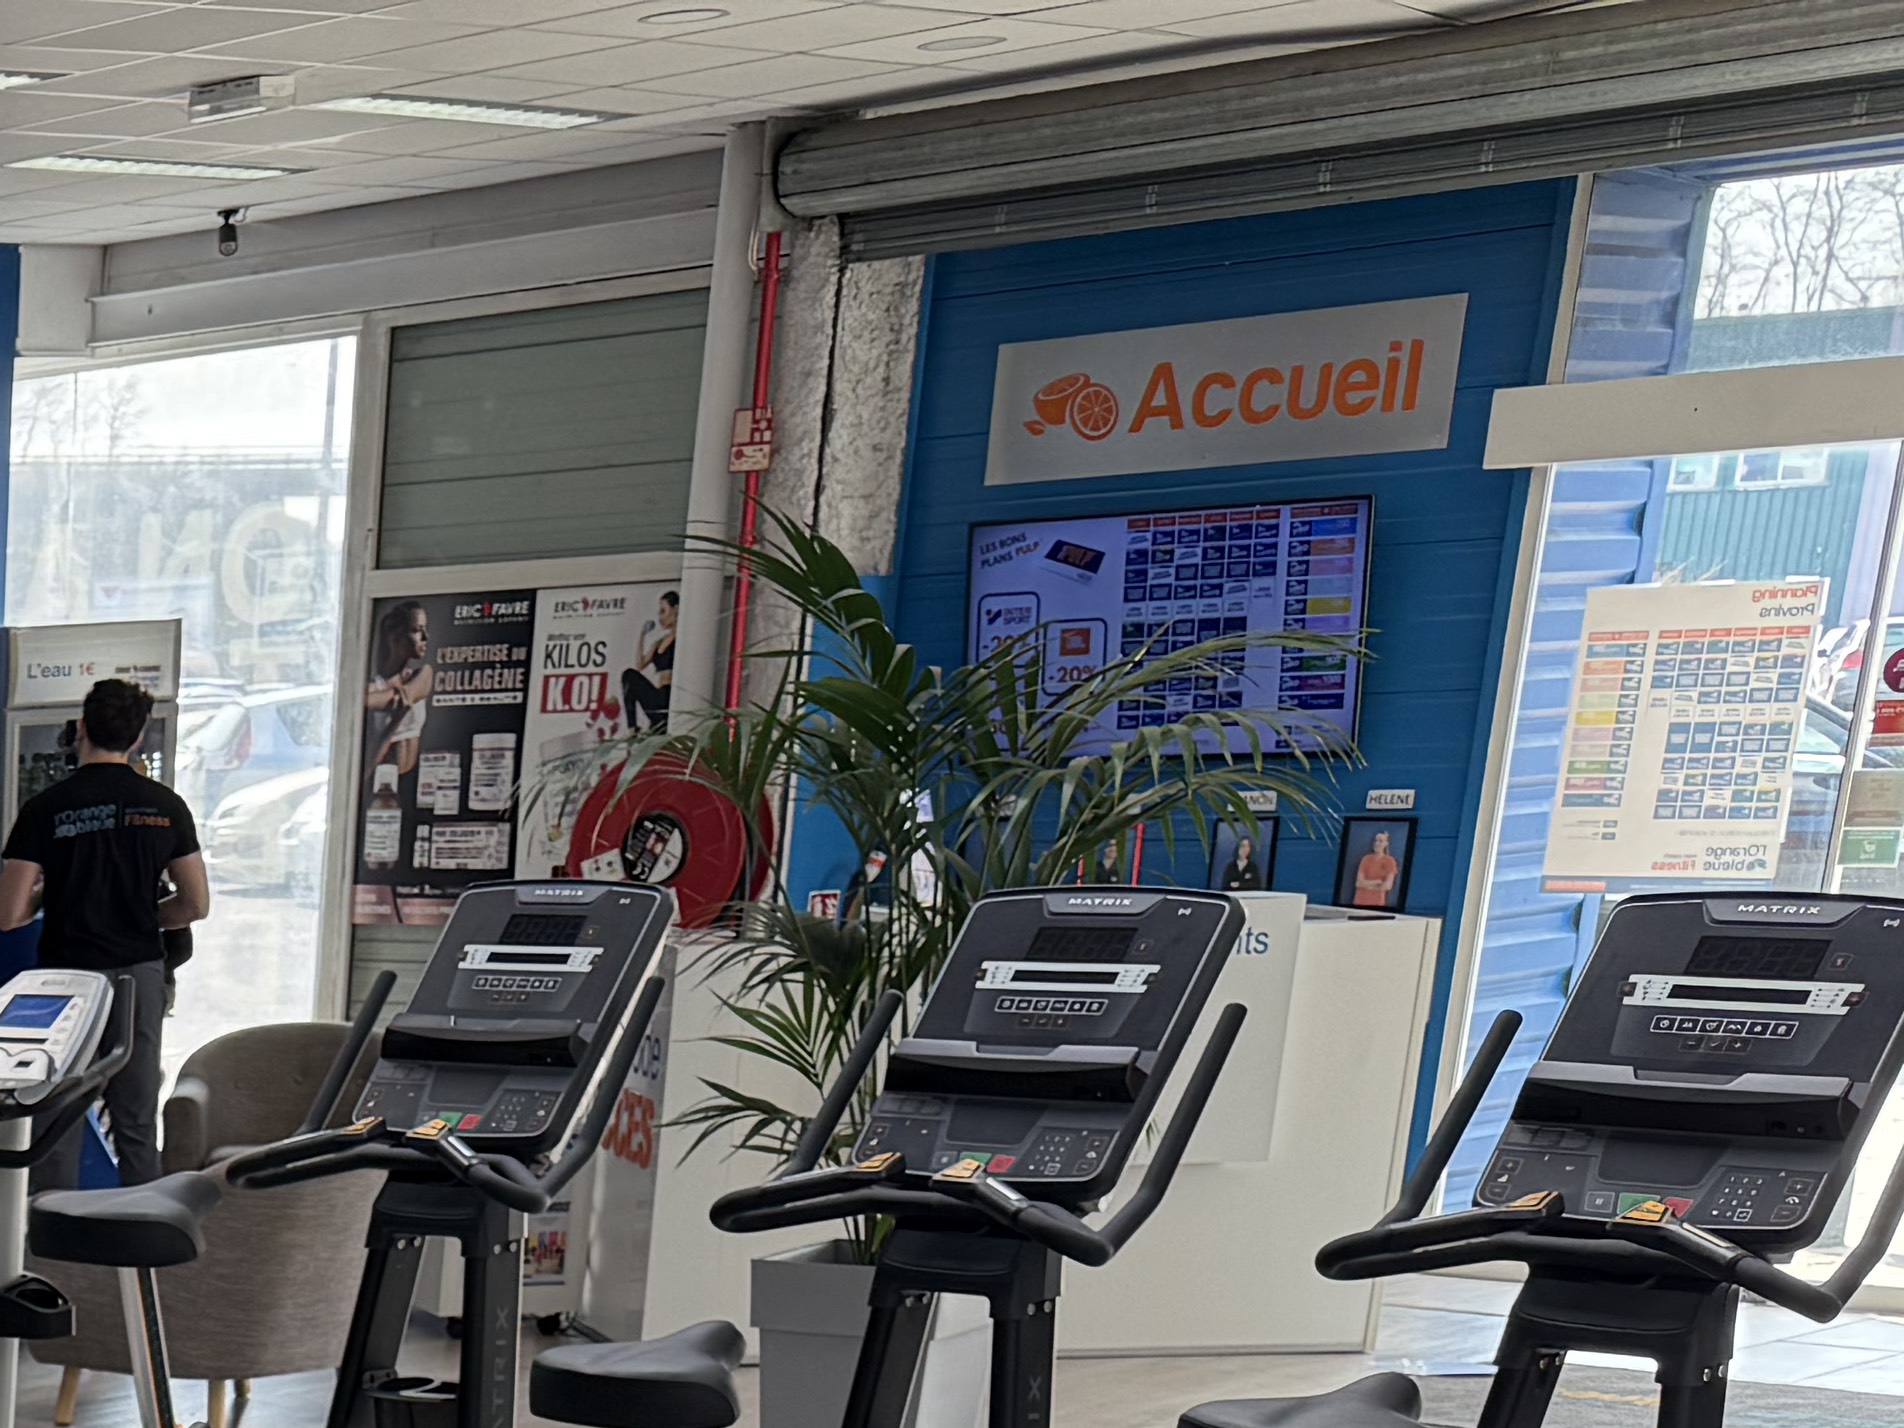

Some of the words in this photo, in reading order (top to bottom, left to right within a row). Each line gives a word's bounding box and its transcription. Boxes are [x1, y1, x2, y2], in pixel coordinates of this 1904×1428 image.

[1127, 337, 1424, 434] Accueil
[544, 641, 608, 670] KILOS
[27, 661, 72, 679] L'eau
[78, 661, 96, 677] 1€
[434, 663, 525, 691] COLLAGÈNE
[546, 675, 603, 711] K.O!
[125, 814, 171, 828] Fitness
[1068, 897, 1133, 907] MATRIX
[1737, 903, 1823, 916] MATRIX
